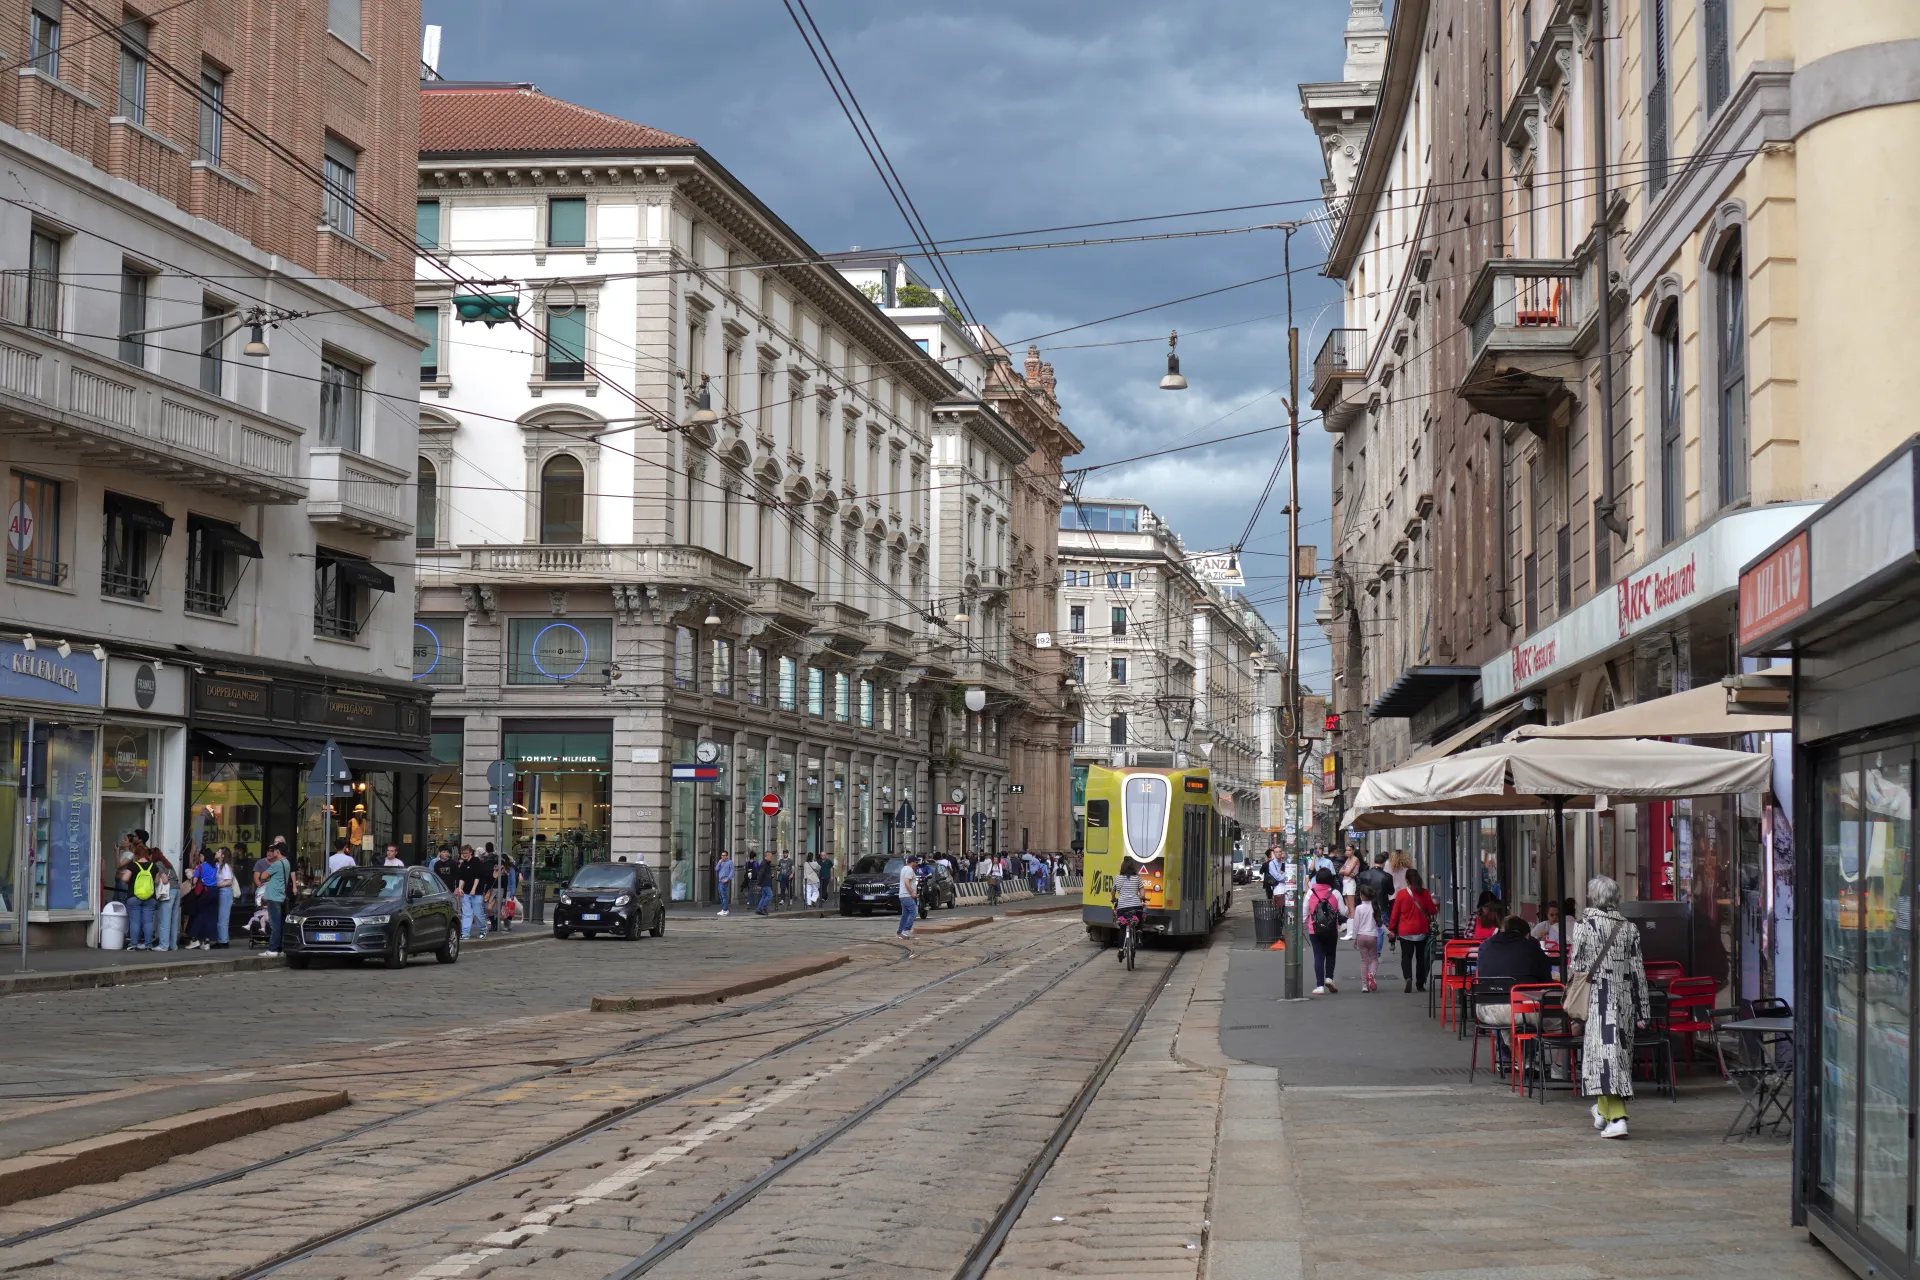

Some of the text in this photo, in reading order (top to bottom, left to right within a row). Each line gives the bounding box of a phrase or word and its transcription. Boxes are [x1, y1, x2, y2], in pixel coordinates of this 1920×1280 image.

[9, 516, 32, 535] AV
[1195, 558, 1228, 570] FANZ
[1630, 552, 1696, 622] KFC Restaurant
[413, 649, 427, 657] NS
[1519, 644, 1536, 681] KFC
[12, 653, 78, 693] KELEMATA
[138, 678, 154, 690] FRANKLY
[118, 752, 135, 764] FRANKLY
[1141, 783, 1152, 793] 12
[69, 771, 86, 832] KELEMATA
[1102, 875, 1114, 892] IED
